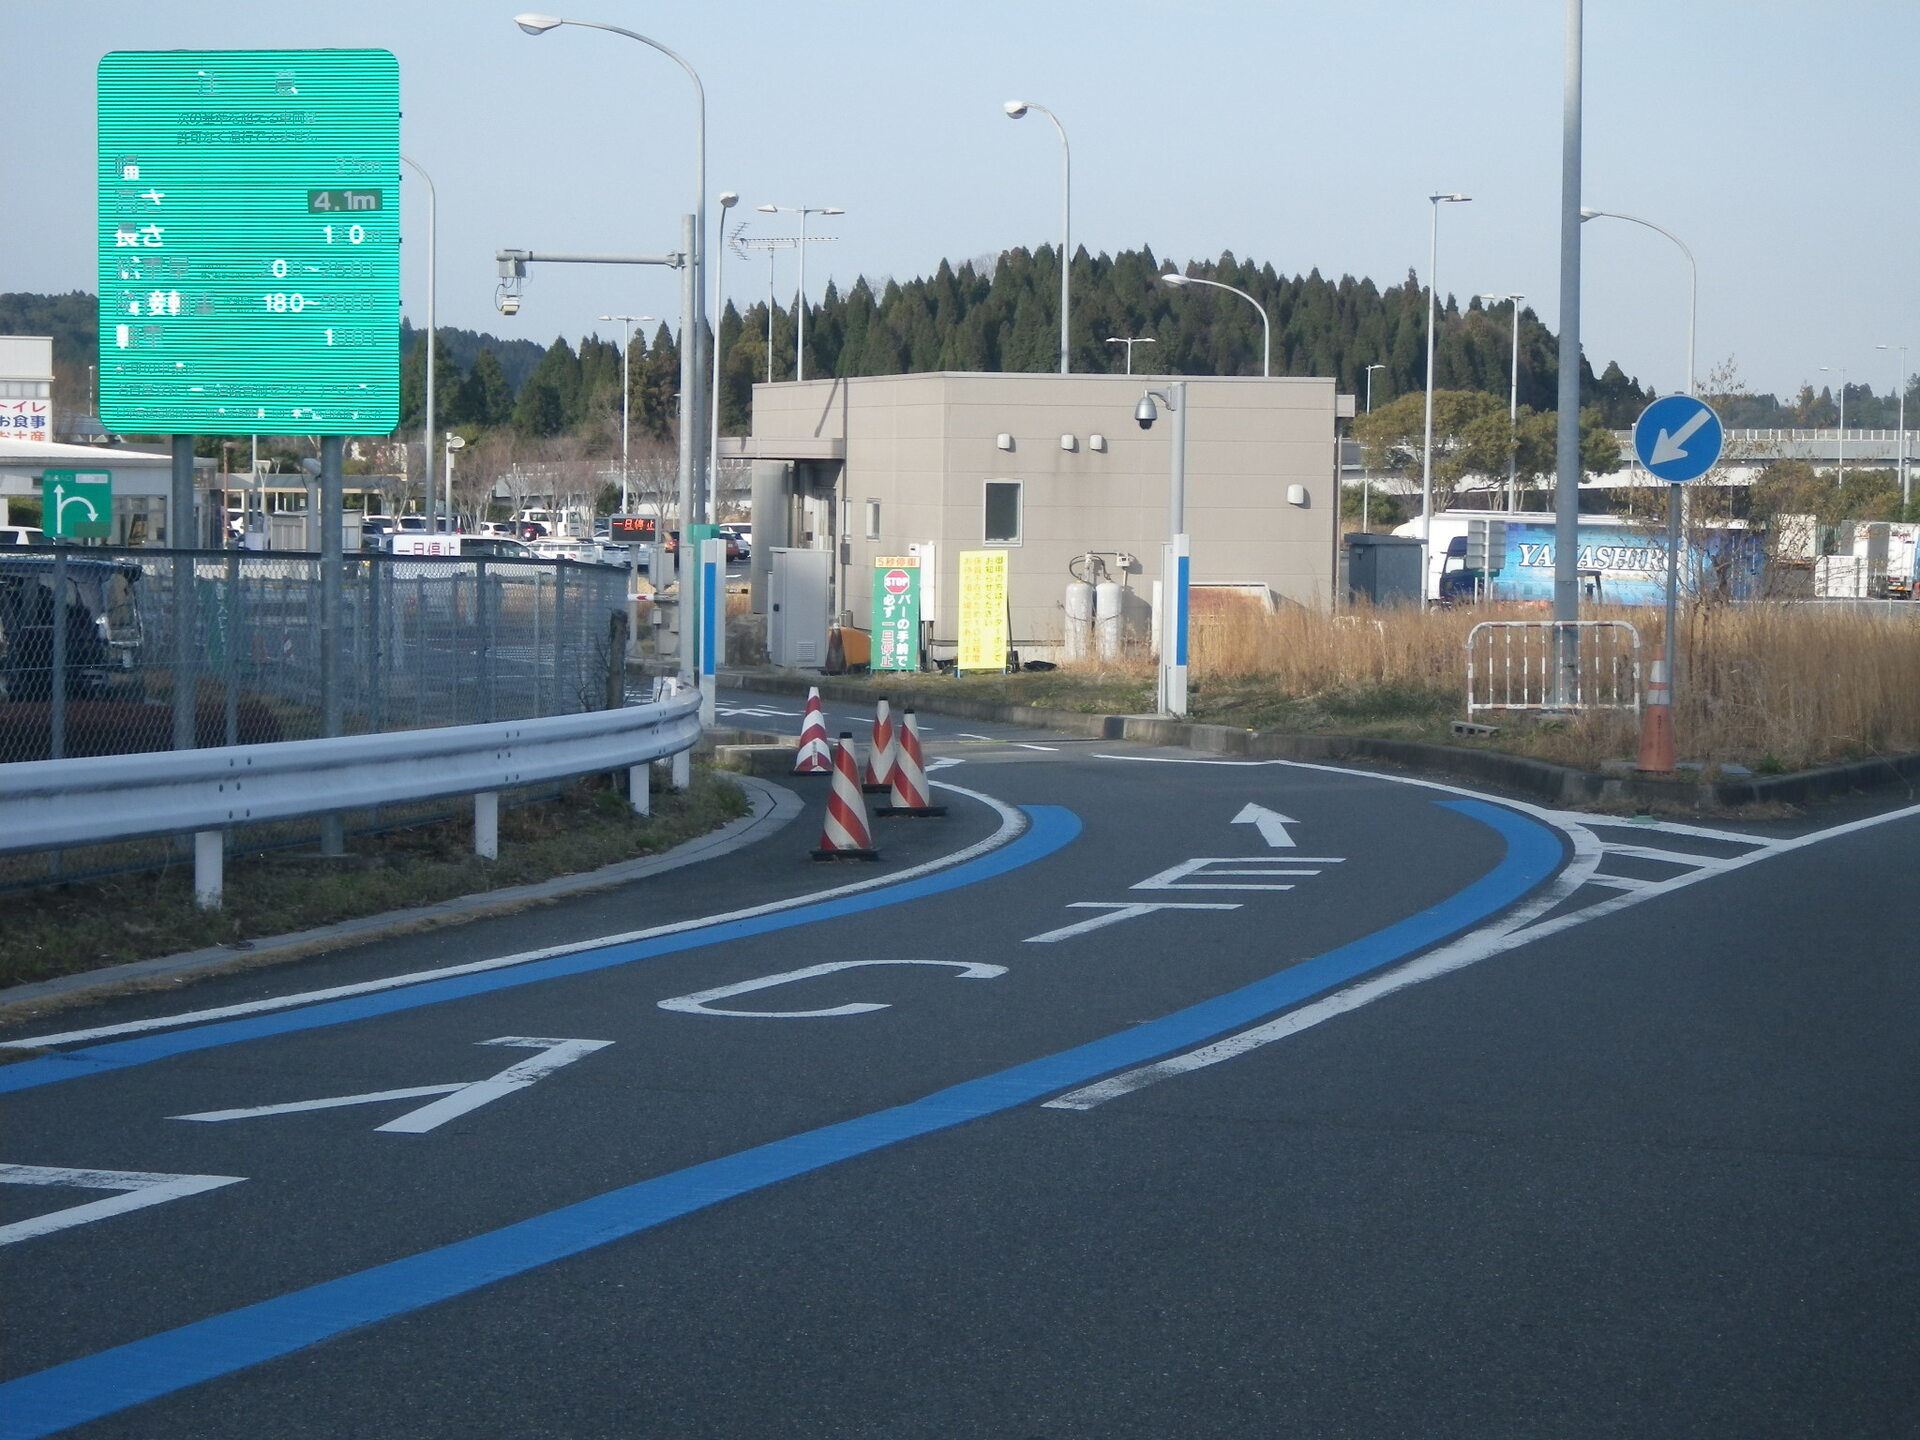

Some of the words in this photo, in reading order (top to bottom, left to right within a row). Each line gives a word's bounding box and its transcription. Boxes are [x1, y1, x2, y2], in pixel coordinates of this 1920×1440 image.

[313, 191, 376, 211] 4.1m
[115, 222, 165, 247] 長さ
[0, 401, 46, 413] イレ
[0, 415, 46, 428] お食事
[612, 518, 656, 530] 一旦停止
[1519, 544, 1684, 571] YAASHIRO
[884, 576, 909, 588] STOP
[880, 594, 896, 668] 必ず一旦停止
[896, 594, 911, 667] バーの手前で
